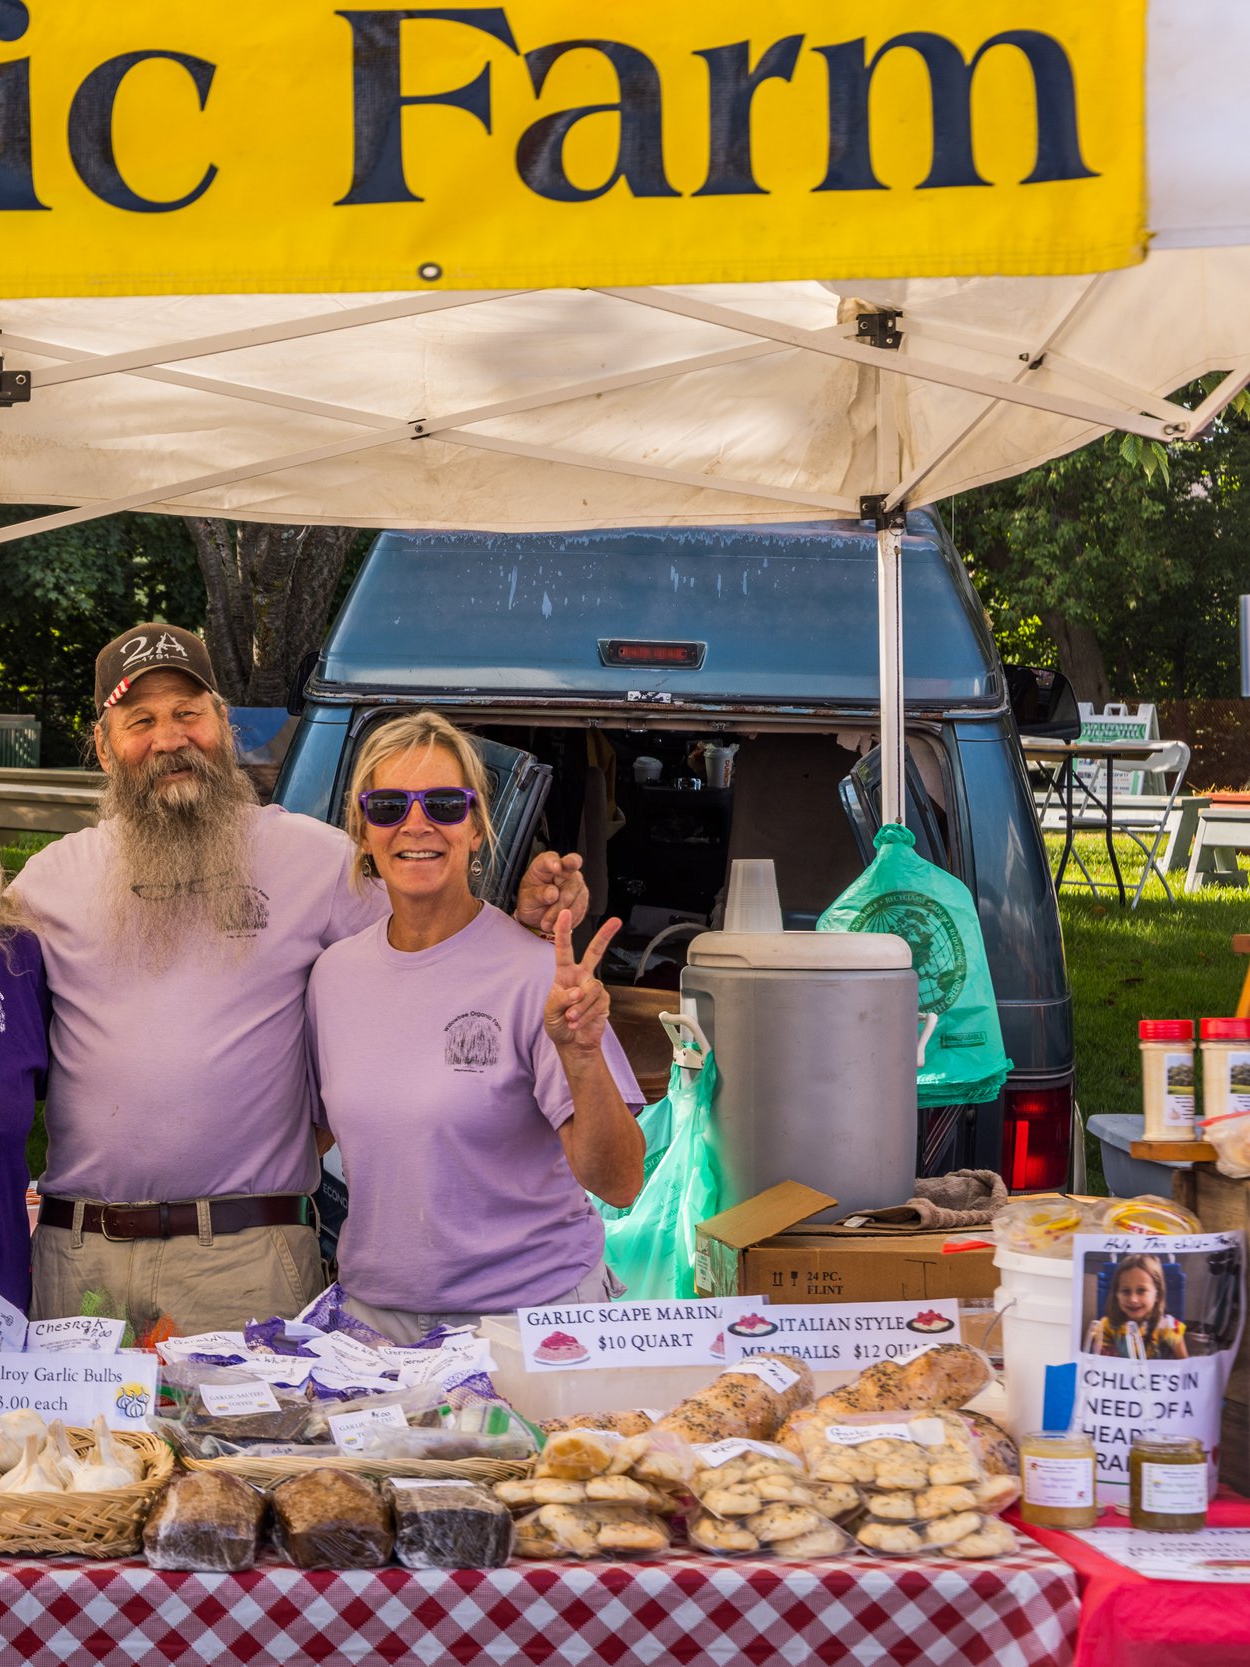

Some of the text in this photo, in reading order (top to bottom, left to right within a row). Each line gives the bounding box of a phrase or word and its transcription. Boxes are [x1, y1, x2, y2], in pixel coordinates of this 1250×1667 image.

[334, 7, 1099, 206] Farm
[120, 632, 187, 667] 2A
[946, 977, 965, 1004] GREEN
[470, 1011, 493, 1020] Organic
[492, 1018, 502, 1032] Farm
[807, 1272, 842, 1281] 24 PC.
[807, 1285, 843, 1295] FLINT
[527, 1309, 595, 1326] GARLIC
[600, 1308, 652, 1323] SCAPE
[779, 1316, 904, 1332] ITALIAN STYLE
[598, 1333, 693, 1352] $10 QUART
[854, 1344, 881, 1359] $12
[34, 1366, 79, 1383] Garlic
[84, 1367, 123, 1383] Bulbs
[1182, 1372, 1200, 1391] IN
[34, 1397, 68, 1411] each
[209, 1391, 264, 1402] GARLIC SALTED
[1086, 1398, 1143, 1419] NEED
[1182, 1401, 1194, 1418] A
[339, 1422, 366, 1432] GARLIC
